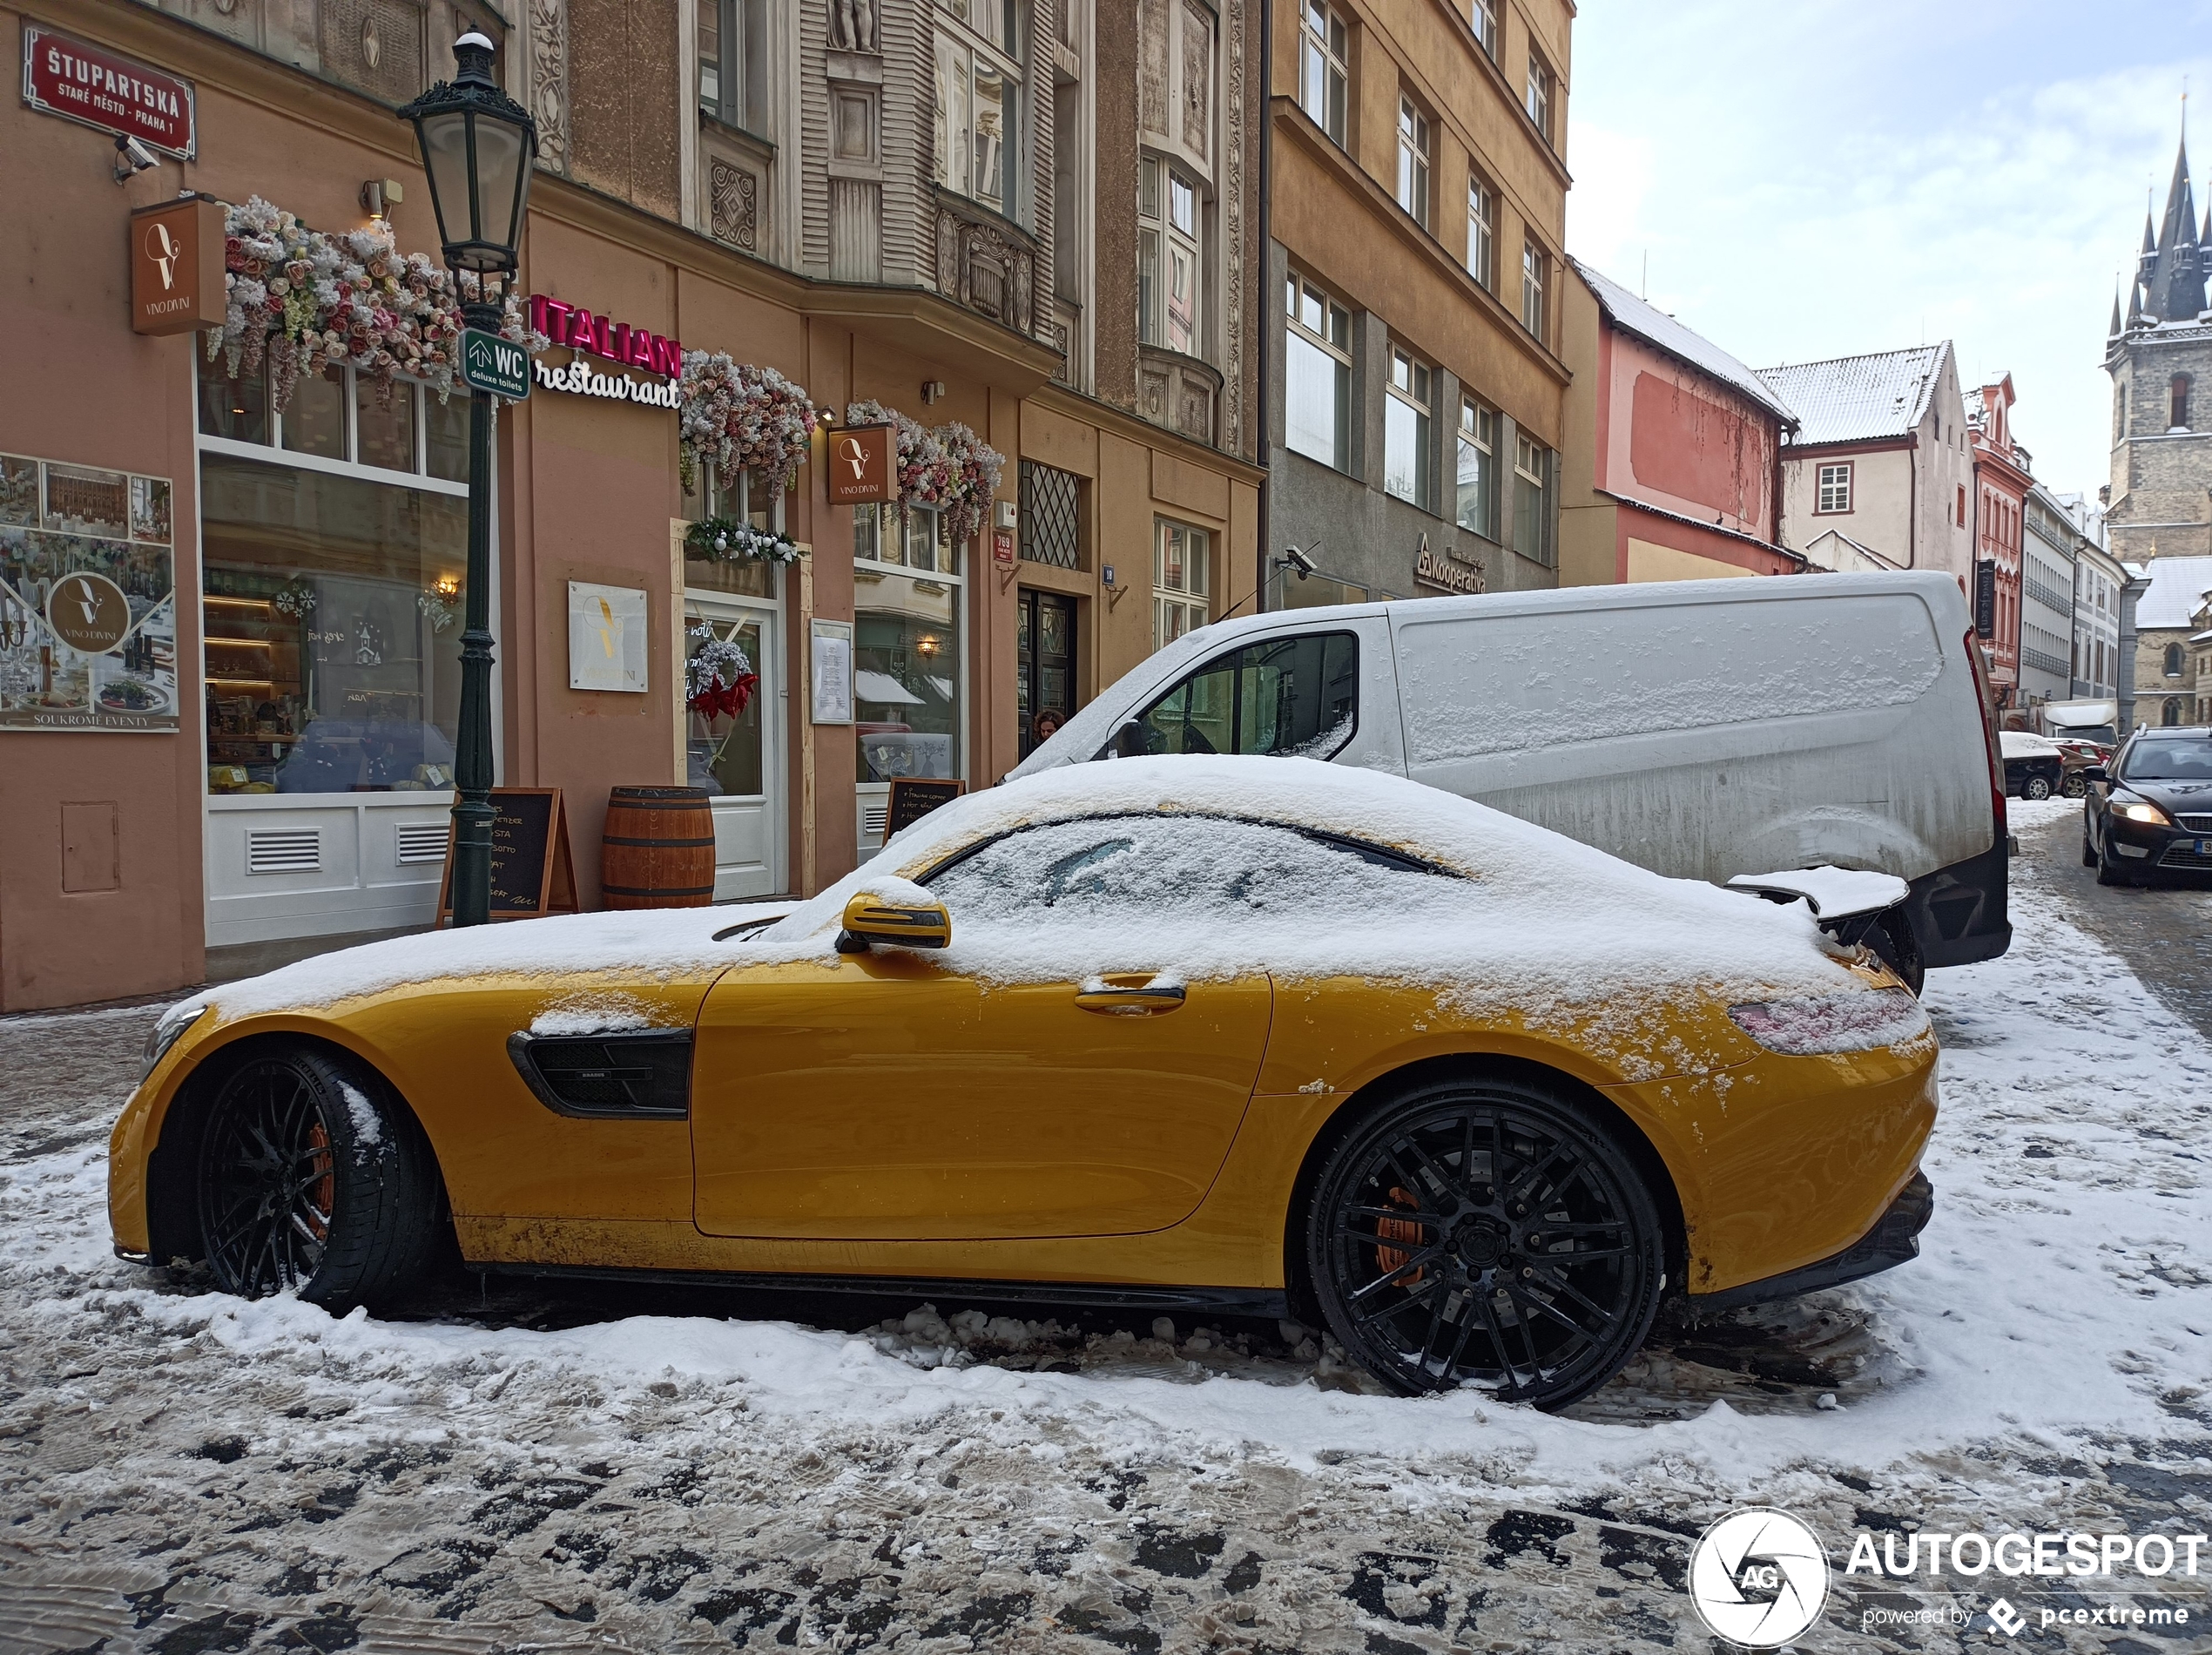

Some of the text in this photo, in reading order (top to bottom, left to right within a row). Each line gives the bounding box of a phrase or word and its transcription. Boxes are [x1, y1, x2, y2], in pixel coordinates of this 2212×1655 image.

[48, 46, 179, 118] ŠTUPARTSKÁ
[58, 83, 89, 104] STARÉ
[93, 94, 125, 116] MĚSTO
[135, 110, 165, 132] PRAHA
[169, 122, 173, 134] 1
[146, 296, 190, 315] VINO DIVINI
[530, 294, 681, 379] ITALIAN
[495, 345, 523, 379] WC
[471, 369, 523, 392] deluxe toilets
[534, 358, 682, 409] restaurant
[840, 484, 879, 495] VINO DIVINI
[1432, 554, 1486, 593] Kooperativa
[65, 629, 117, 640] VINO DIVINI
[34, 714, 150, 726] SOUKROMÉ EVENTY
